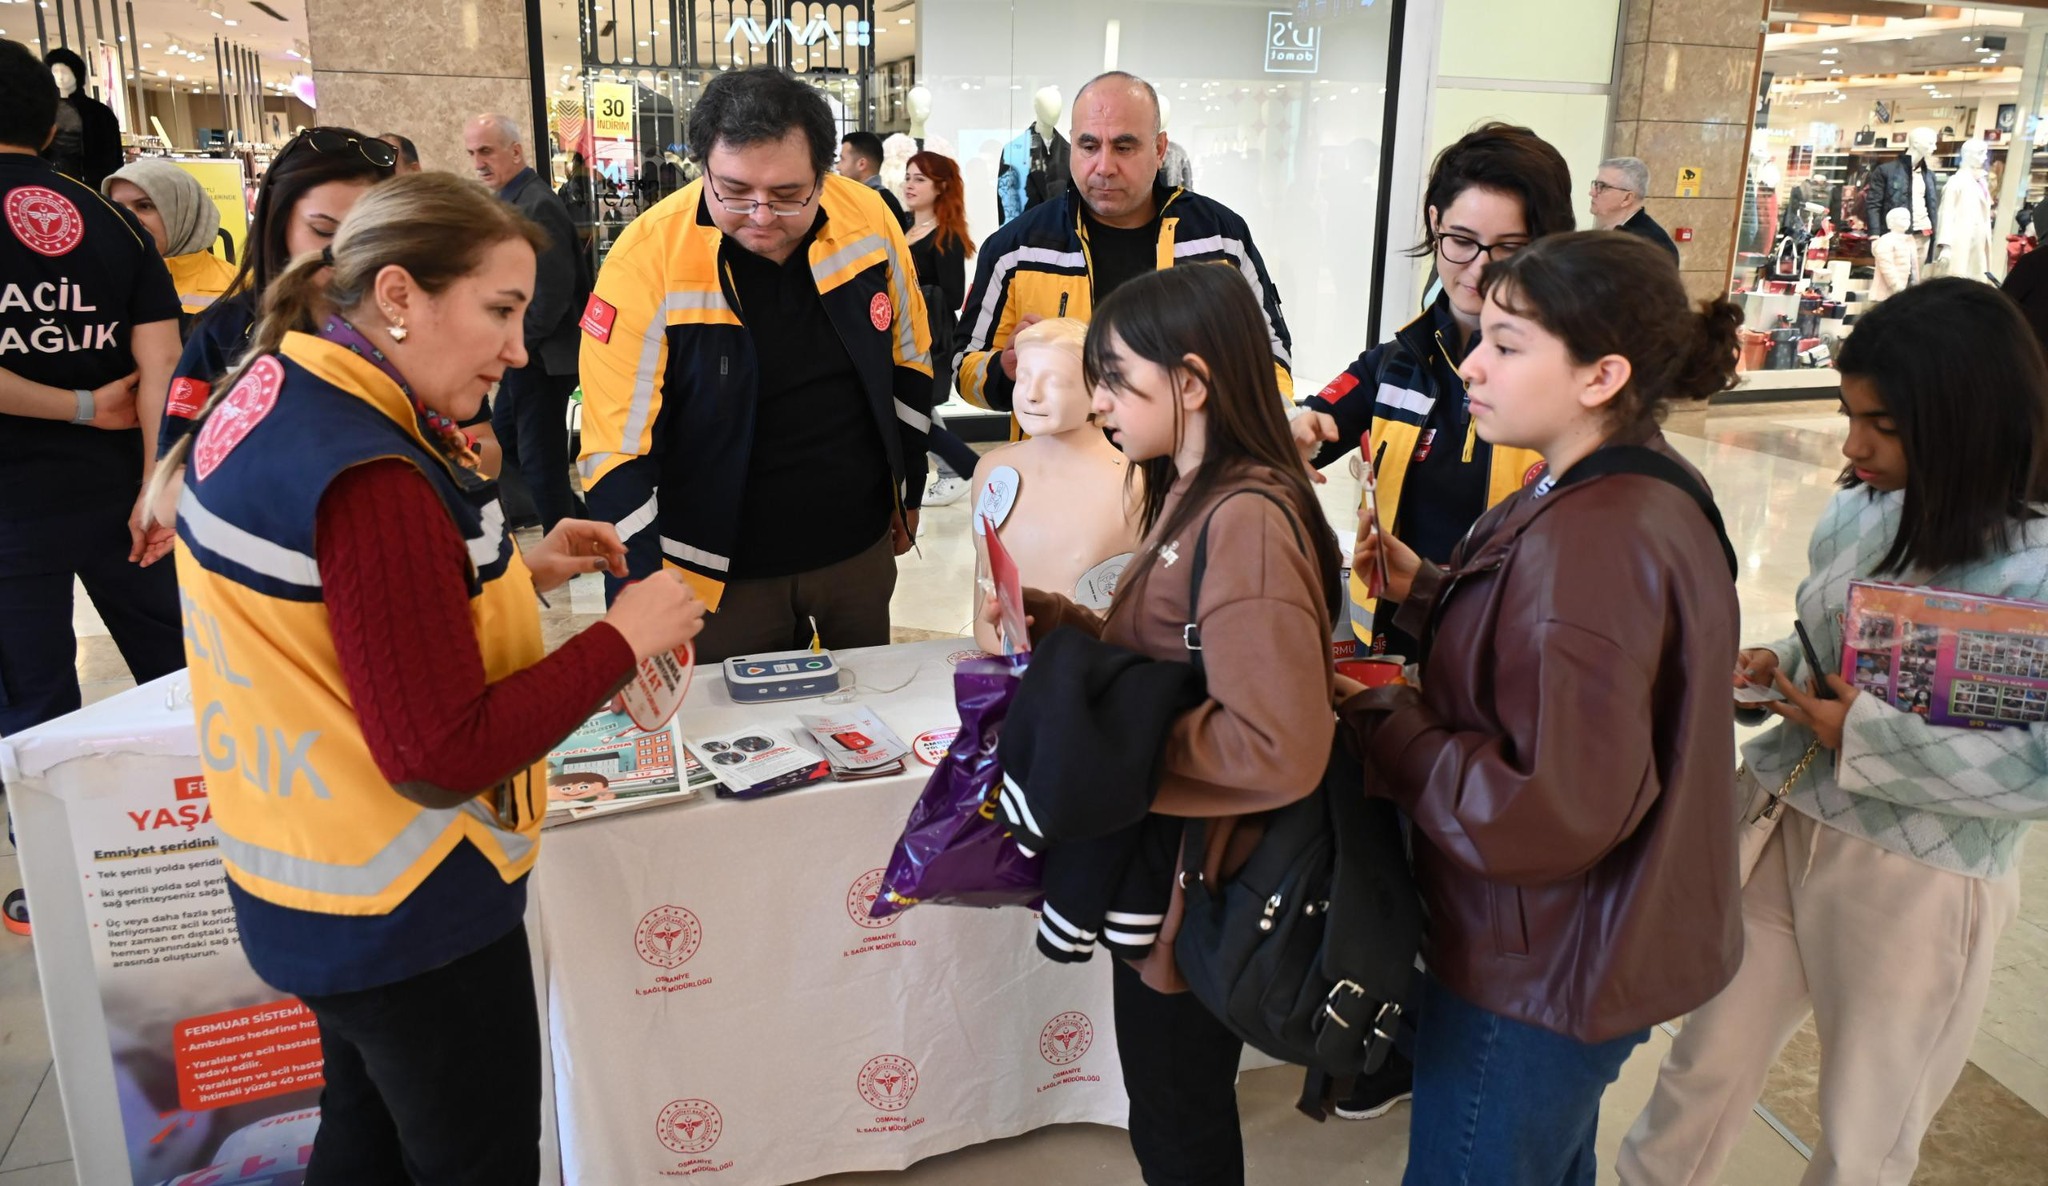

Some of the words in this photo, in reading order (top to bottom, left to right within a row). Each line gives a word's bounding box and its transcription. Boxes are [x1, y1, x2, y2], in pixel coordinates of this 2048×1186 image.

[724, 17, 840, 46] AVVA
[602, 98, 624, 117] 30
[597, 117, 630, 131] İNDİRİM
[0, 277, 97, 314] ACİL
[0, 318, 120, 355] AĞLIK
[640, 656, 662, 693] AYAT
[94, 844, 156, 859] Emniyet
[98, 871, 117, 879] Tek
[120, 866, 152, 878] şeritli
[155, 863, 185, 875] yolda
[100, 889, 114, 897] İki
[117, 884, 149, 897] şeritli
[152, 881, 182, 893] yolda
[185, 880, 201, 889] sol
[103, 899, 122, 908] sağ
[125, 891, 195, 907] şeritteyseniz
[198, 887, 225, 897] sağa
[106, 918, 120, 928] Üç
[123, 917, 149, 927] veya
[152, 913, 180, 923] daha
[182, 910, 208, 919] fazla
[107, 923, 178, 938] ilerliyorsanız
[181, 921, 199, 930] acil
[109, 938, 128, 948] her
[131, 935, 168, 945] zaman
[187, 927, 225, 939] dıştaki
[111, 947, 150, 958] hemen
[153, 941, 207, 955] yanındaki
[210, 937, 229, 946] sağ
[113, 955, 160, 968] arasında
[163, 950, 219, 962] oluşturun.
[655, 972, 690, 983] OSMANİYE
[185, 1016, 250, 1037] FERMUAR
[252, 1003, 303, 1025] SİSTEMİ
[189, 1034, 246, 1052] Ambulans
[247, 1025, 298, 1040] hedefine
[193, 1054, 238, 1069] Yaralılar
[240, 1052, 253, 1060] ve
[256, 1046, 275, 1056] acil
[194, 1067, 229, 1080] tedavi
[232, 1060, 263, 1072] edilir.
[198, 1074, 253, 1092] Yaralıların
[256, 1072, 268, 1080] ve
[271, 1066, 290, 1077] acil
[1053, 1067, 1082, 1079] OSMANİYE
[200, 1087, 242, 1102] ihtimali
[244, 1081, 277, 1095] yüzde
[280, 1076, 294, 1085] 40
[678, 1159, 713, 1168] OSMANİYE
